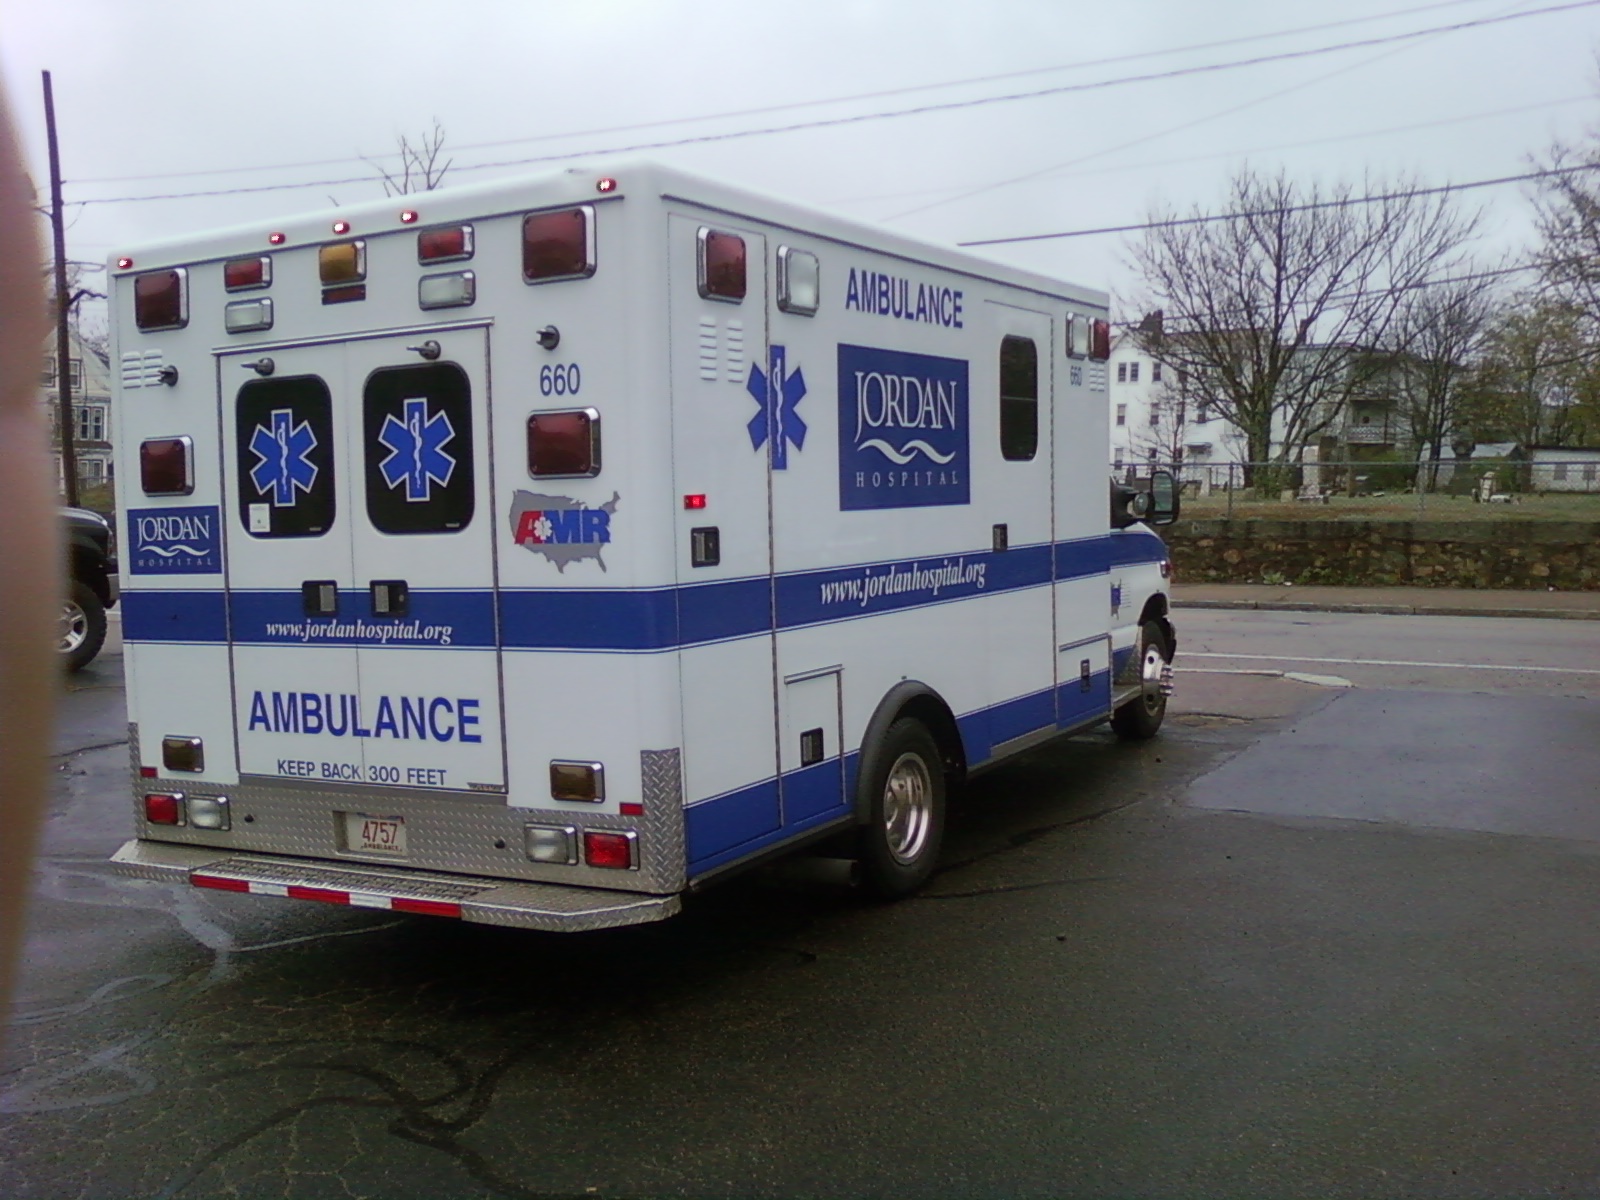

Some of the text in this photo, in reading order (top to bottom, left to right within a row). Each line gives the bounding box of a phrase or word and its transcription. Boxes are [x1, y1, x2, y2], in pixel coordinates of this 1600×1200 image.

[845, 267, 963, 329] AMBULANCE
[539, 363, 581, 397] 660
[854, 371, 957, 443] JORDAN
[856, 471, 958, 488] HOSPITAL
[137, 515, 210, 548] JORDAN
[514, 509, 611, 545] AMR
[138, 558, 212, 567] HOSPITAL
[820, 557, 986, 608] www.jordanhospital.org
[266, 618, 453, 645] www.jordanhospital.org
[248, 690, 482, 744] AMBULANCE
[277, 759, 447, 786] KEEP BACK 300 FEET
[362, 821, 398, 844] 4757
